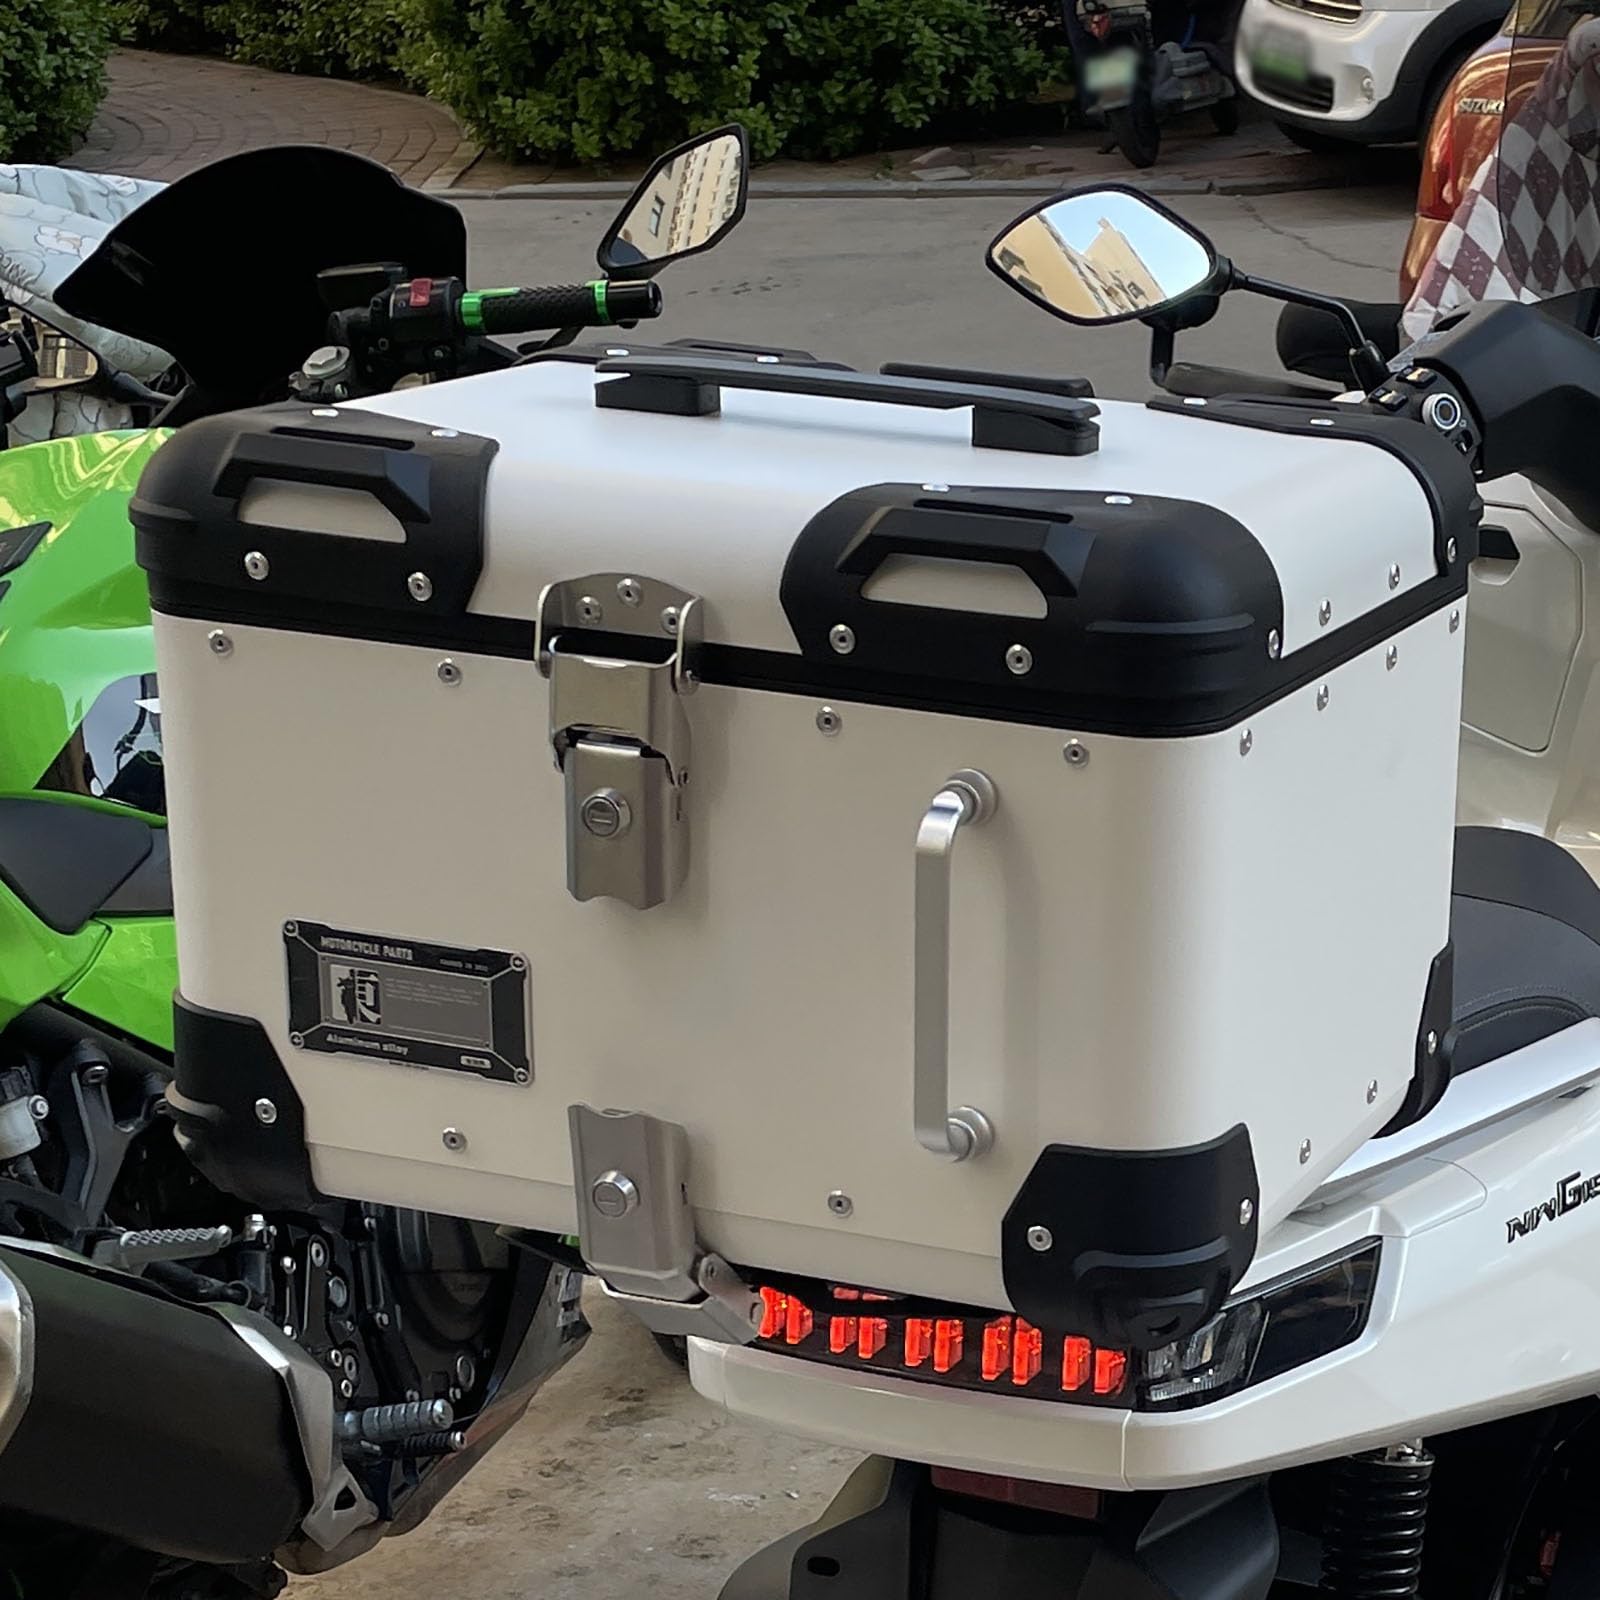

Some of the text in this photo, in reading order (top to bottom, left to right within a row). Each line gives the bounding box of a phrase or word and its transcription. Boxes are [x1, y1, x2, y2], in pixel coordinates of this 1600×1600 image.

[320, 936, 413, 960] MOTORCYCLE PARTS
[326, 1033, 409, 1056] Aluminum alloy
